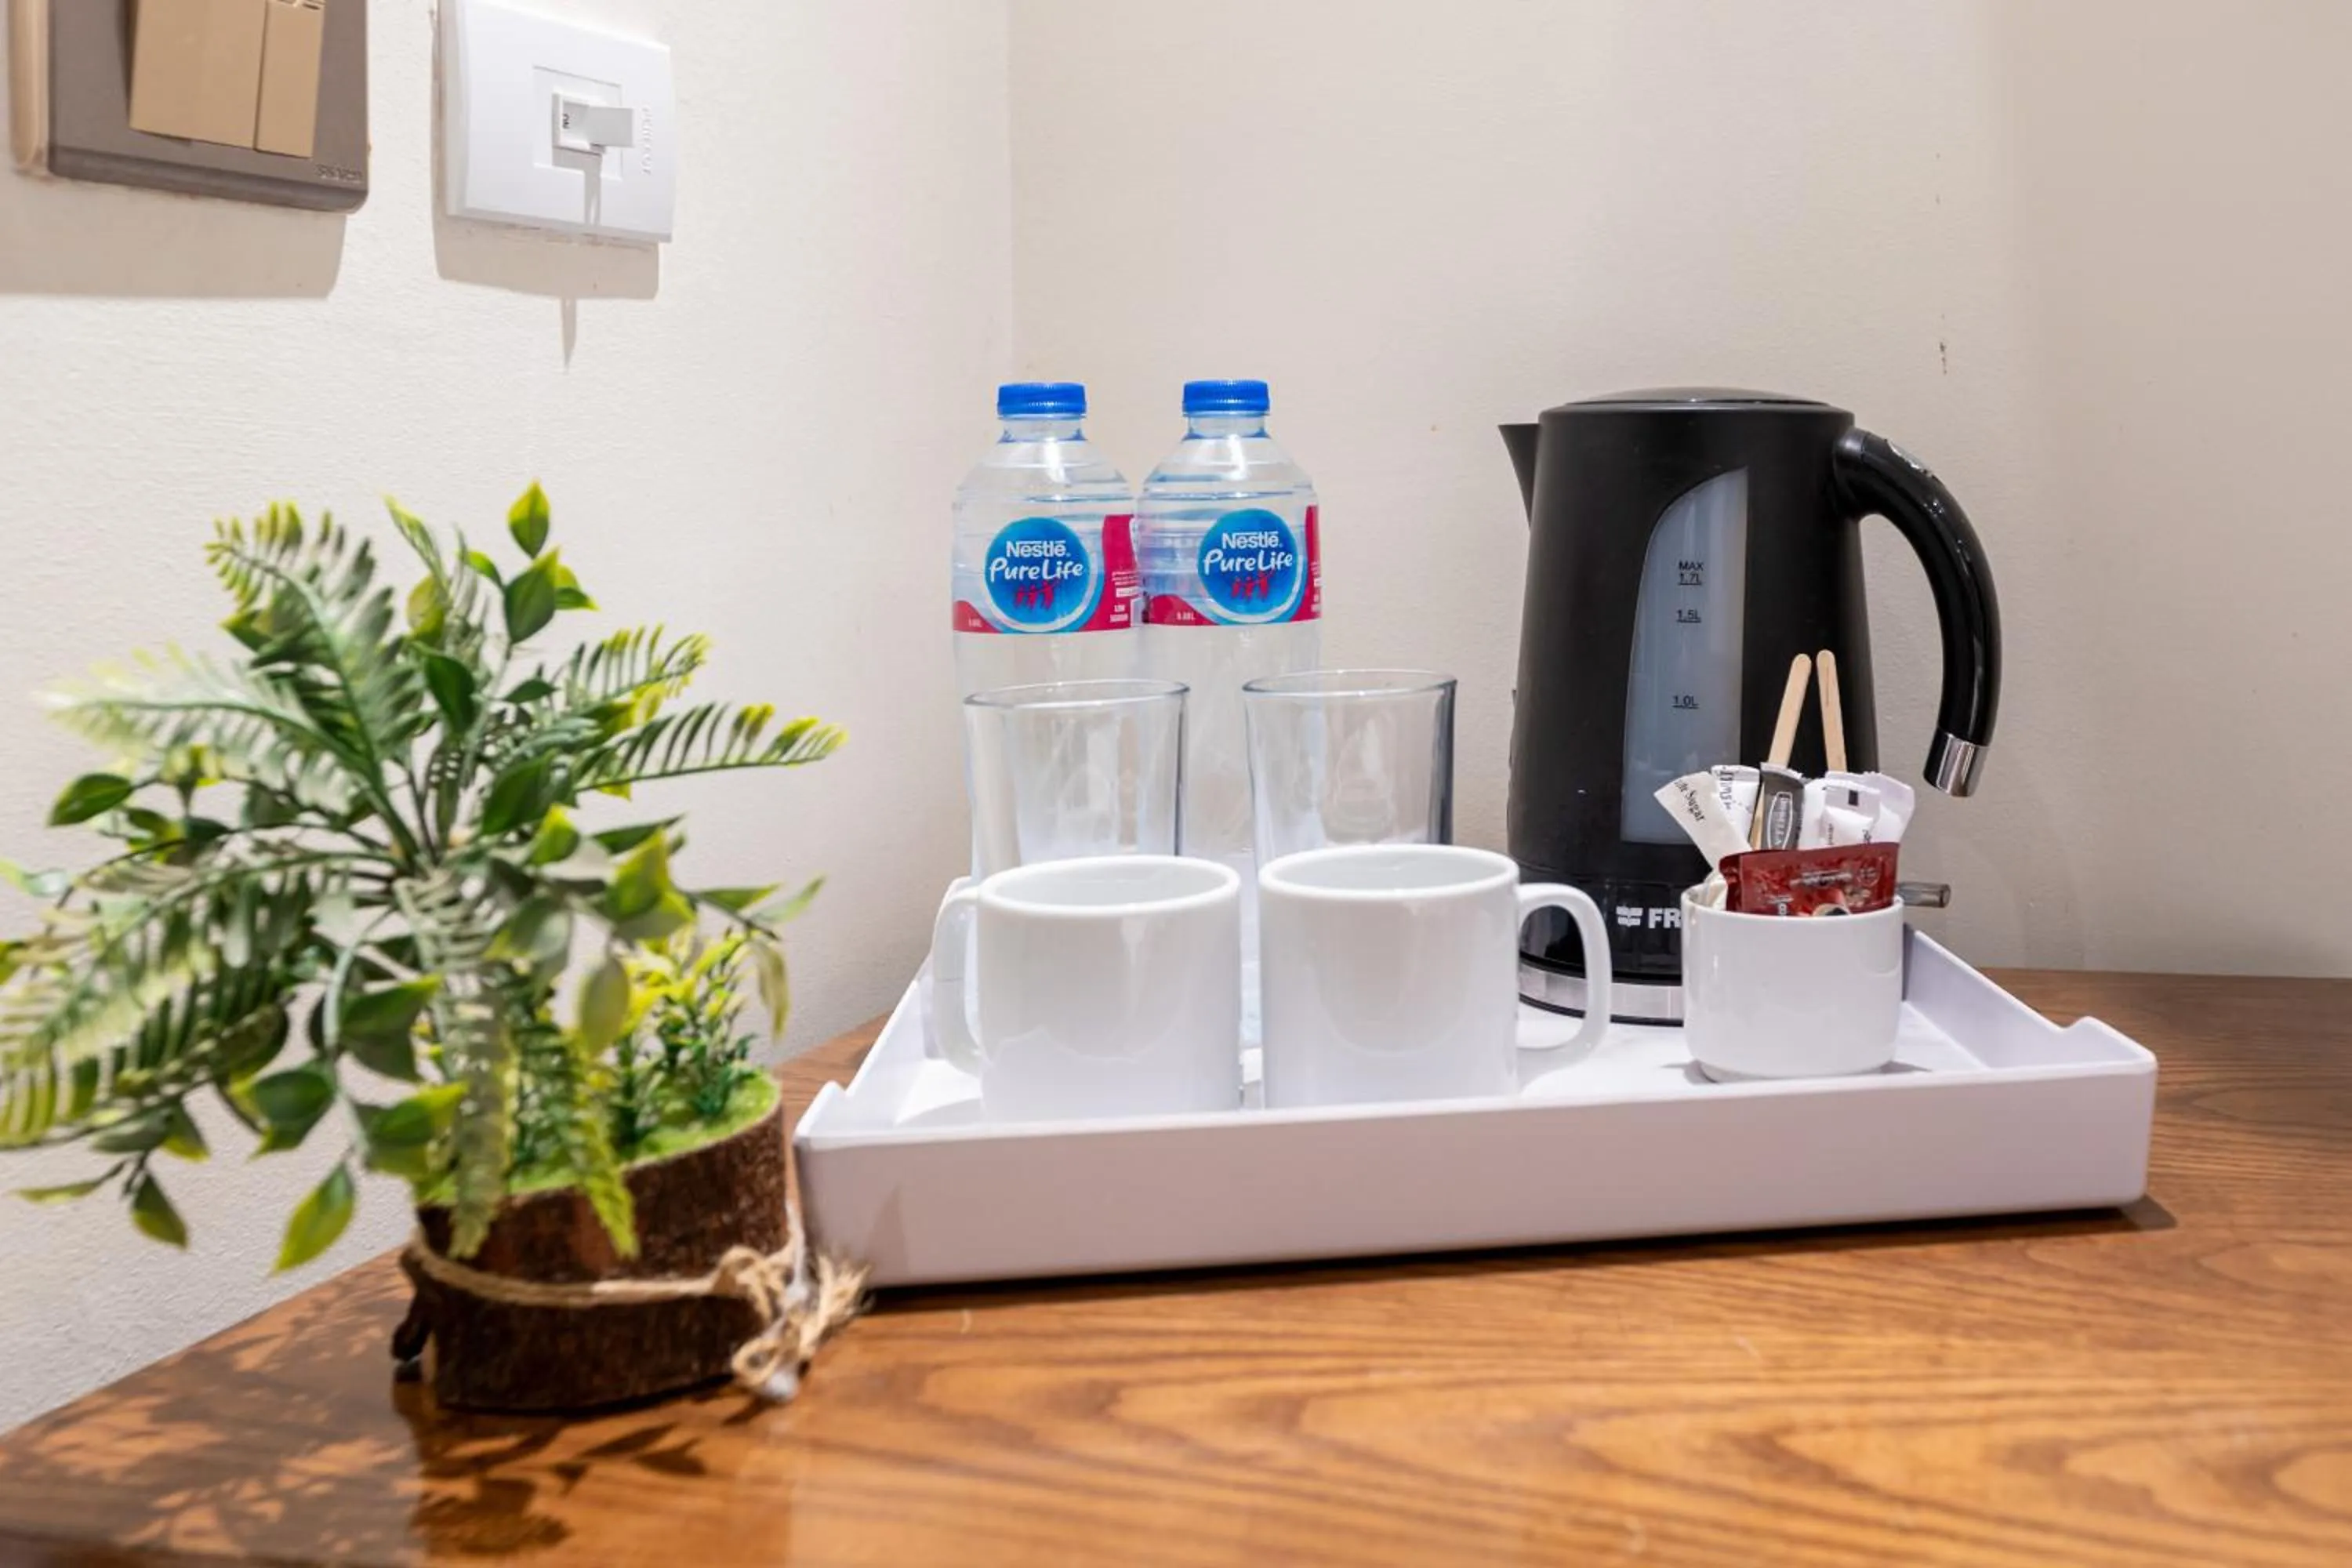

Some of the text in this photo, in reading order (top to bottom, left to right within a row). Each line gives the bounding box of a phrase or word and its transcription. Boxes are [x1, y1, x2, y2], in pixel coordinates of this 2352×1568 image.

[1678, 561, 1704, 572] MAX
[1679, 572, 1702, 583] 1.7L
[1676, 609, 1701, 620] 1.5L
[1673, 695, 1700, 706] 1.0L
